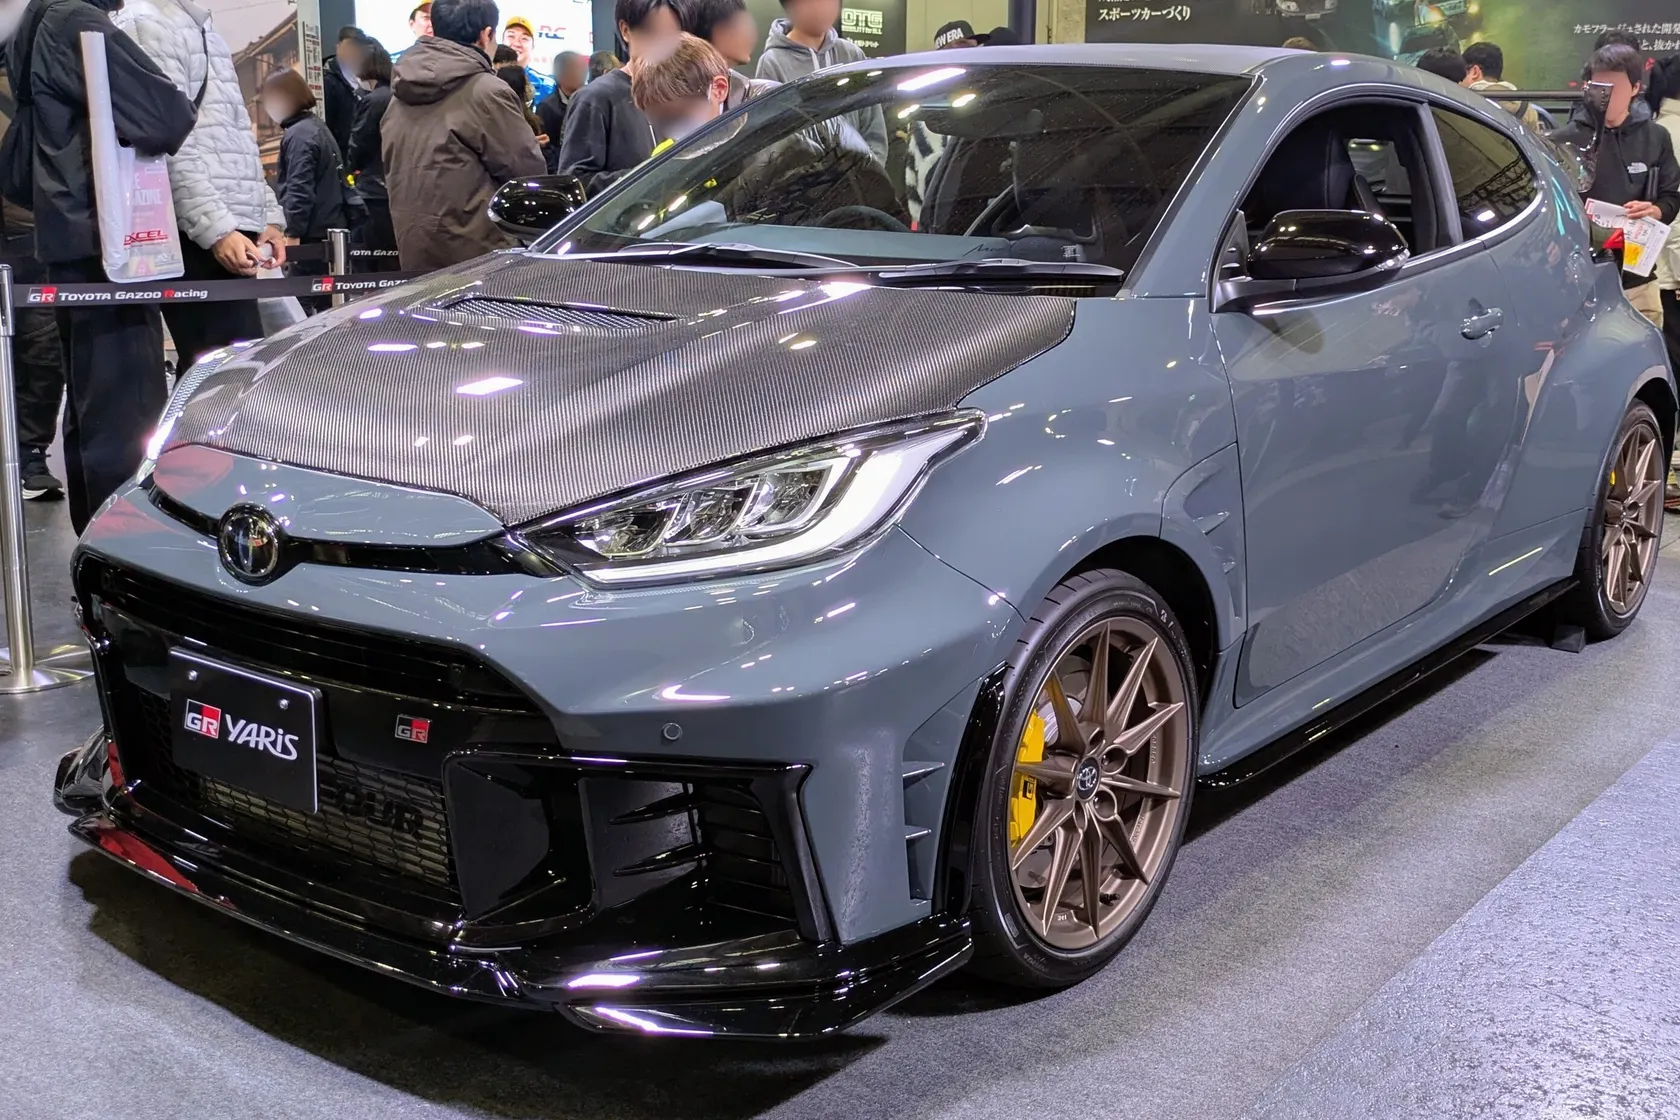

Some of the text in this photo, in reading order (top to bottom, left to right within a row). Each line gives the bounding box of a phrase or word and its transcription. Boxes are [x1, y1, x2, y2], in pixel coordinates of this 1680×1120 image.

[841, 8, 883, 29] OTG
[1098, 5, 1191, 21] スポーツカーづくり
[935, 28, 965, 49] EW ERA
[28, 289, 208, 303] GR TOYOTA GAZOO Racing
[311, 280, 334, 292] GR
[336, 281, 376, 290] TOYOTA
[186, 709, 220, 738] GR
[396, 722, 429, 743] GR
